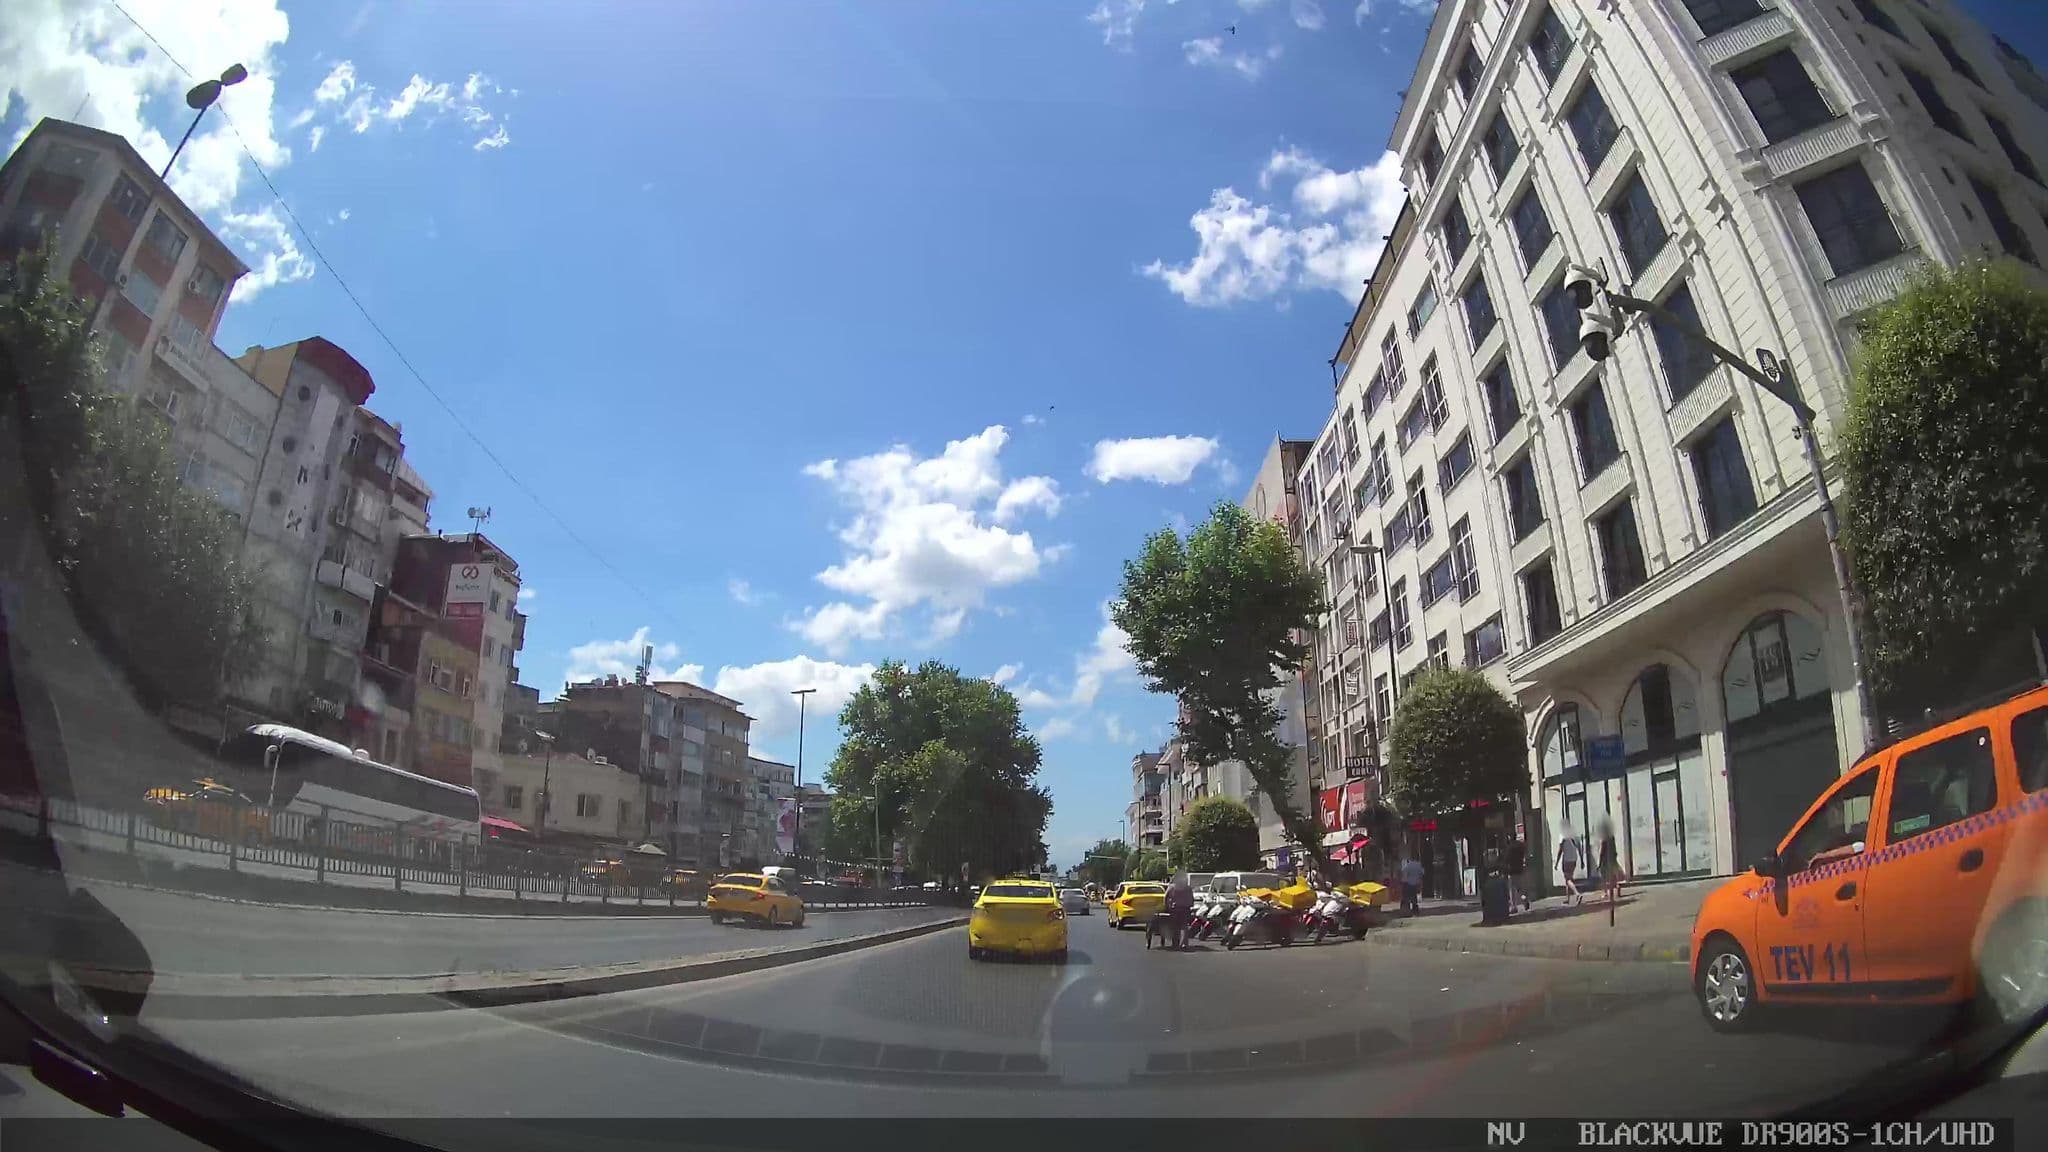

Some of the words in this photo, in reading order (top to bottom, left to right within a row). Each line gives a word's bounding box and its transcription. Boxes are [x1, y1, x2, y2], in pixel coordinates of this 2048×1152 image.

[1347, 757, 1374, 768] HOTEL
[1770, 944, 1816, 981] TEV
[1825, 942, 1852, 982] 11
